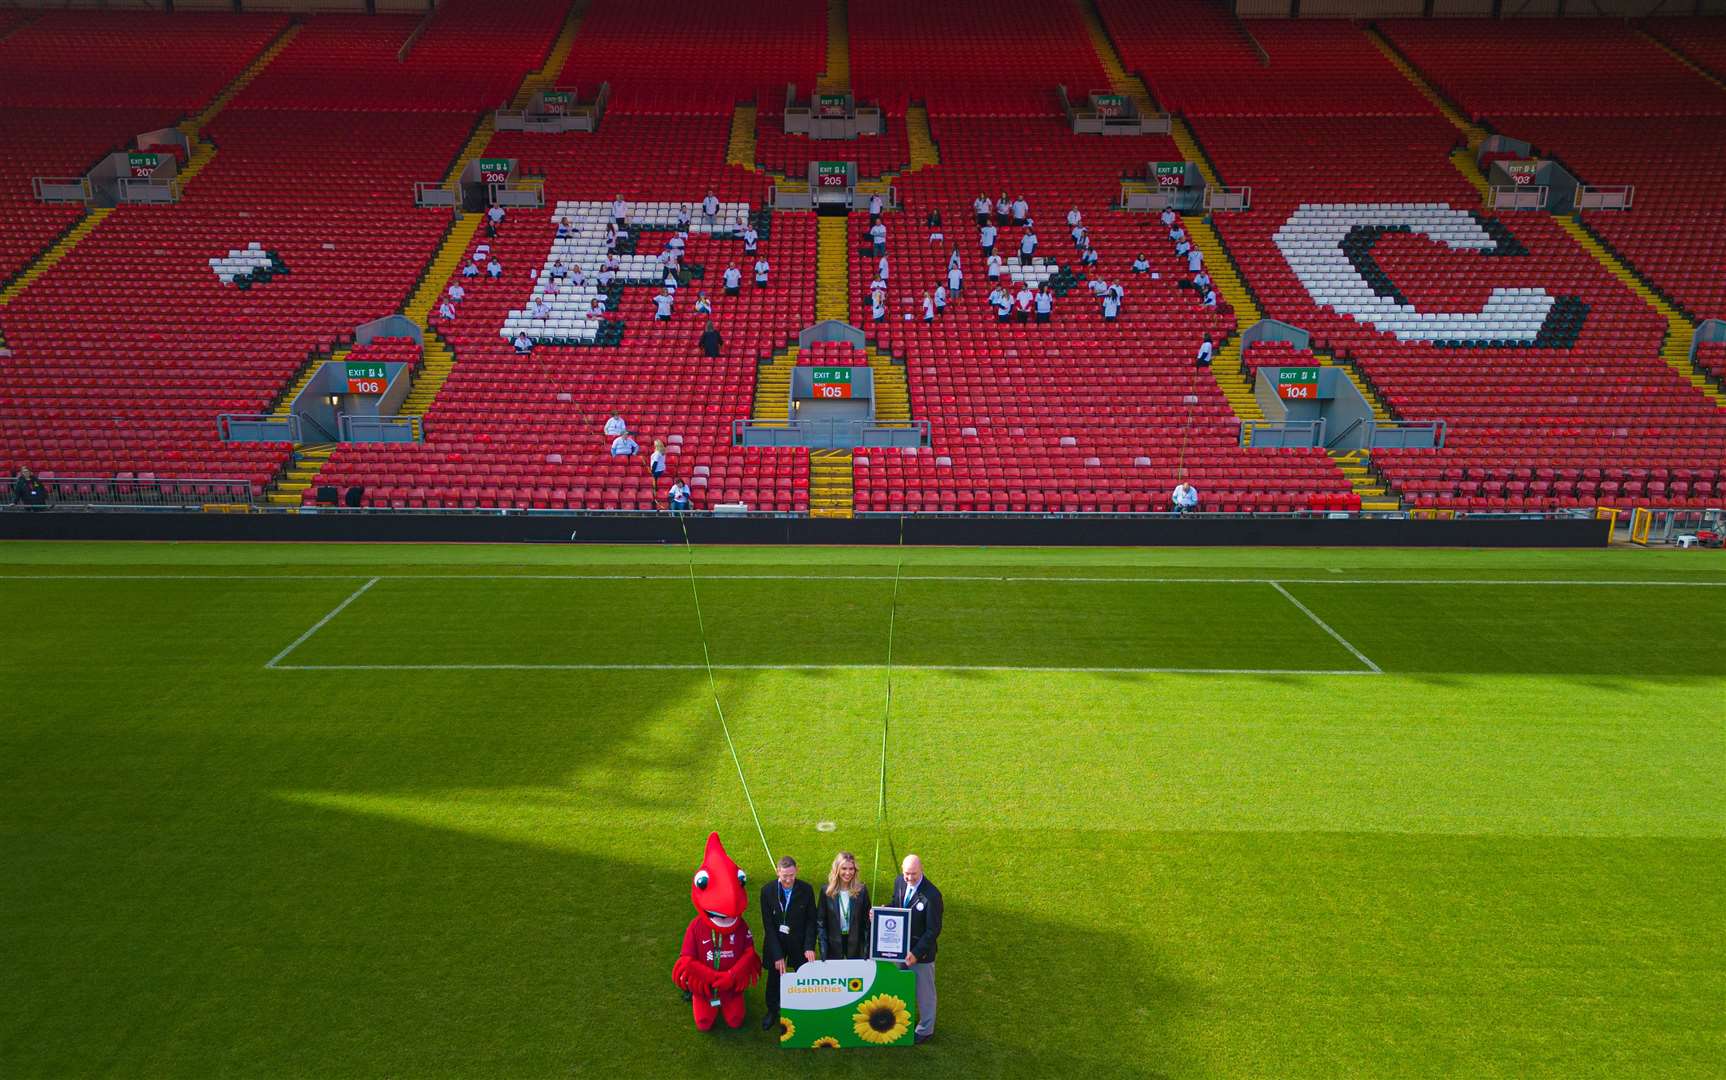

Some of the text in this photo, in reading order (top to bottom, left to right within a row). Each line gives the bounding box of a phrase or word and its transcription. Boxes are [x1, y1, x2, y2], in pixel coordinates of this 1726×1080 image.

[487, 173, 505, 182] 206
[824, 176, 841, 185] 205
[1161, 177, 1180, 186] 204
[356, 382, 379, 393] 106
[821, 387, 842, 398] 105
[1286, 387, 1308, 398] 104
[787, 985, 842, 993] disabilities
